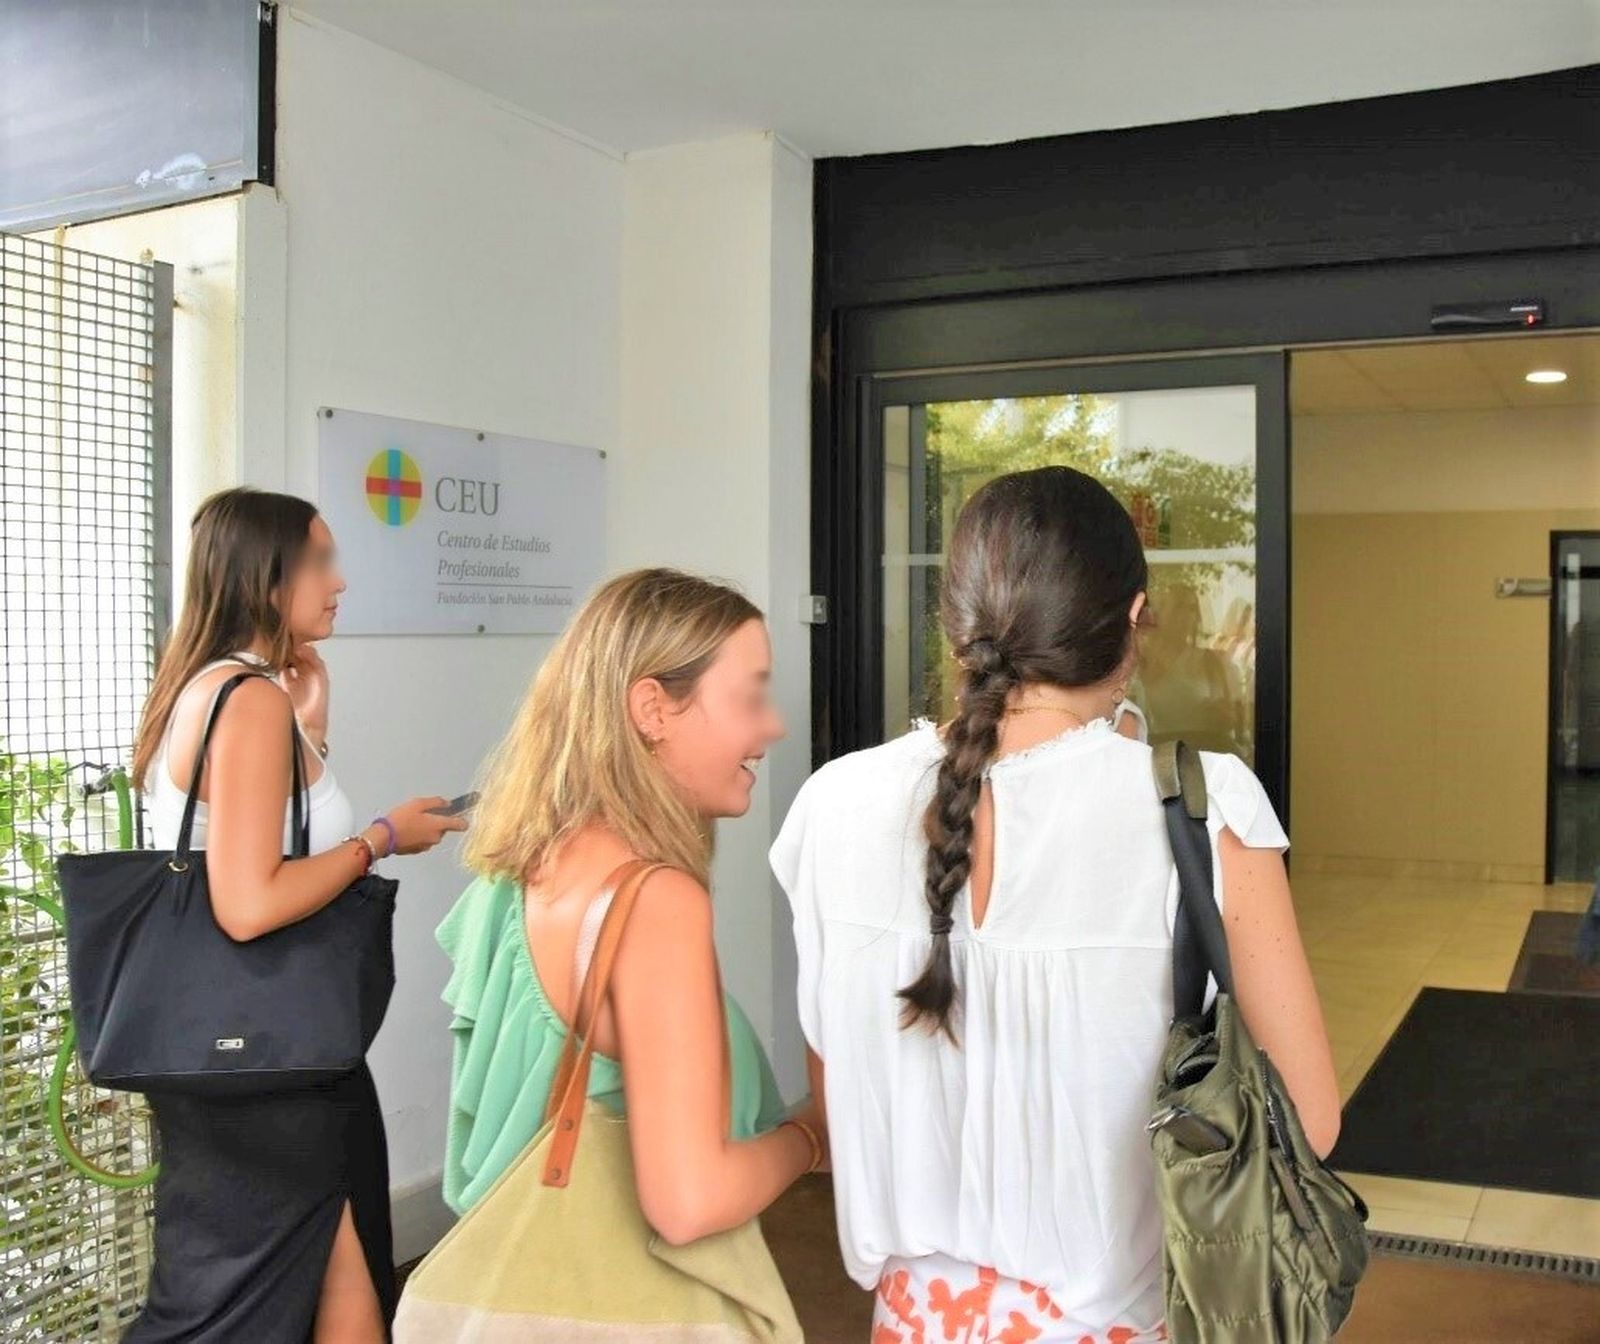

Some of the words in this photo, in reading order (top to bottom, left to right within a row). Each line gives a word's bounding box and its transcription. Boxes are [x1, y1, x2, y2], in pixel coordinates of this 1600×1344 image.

[435, 477, 501, 516] CEU
[437, 530, 481, 550] Centro
[483, 533, 499, 550] de
[501, 536, 551, 553] Estudios
[437, 559, 520, 581] Profesionales
[437, 592, 486, 605] Fundación
[488, 592, 505, 606] San
